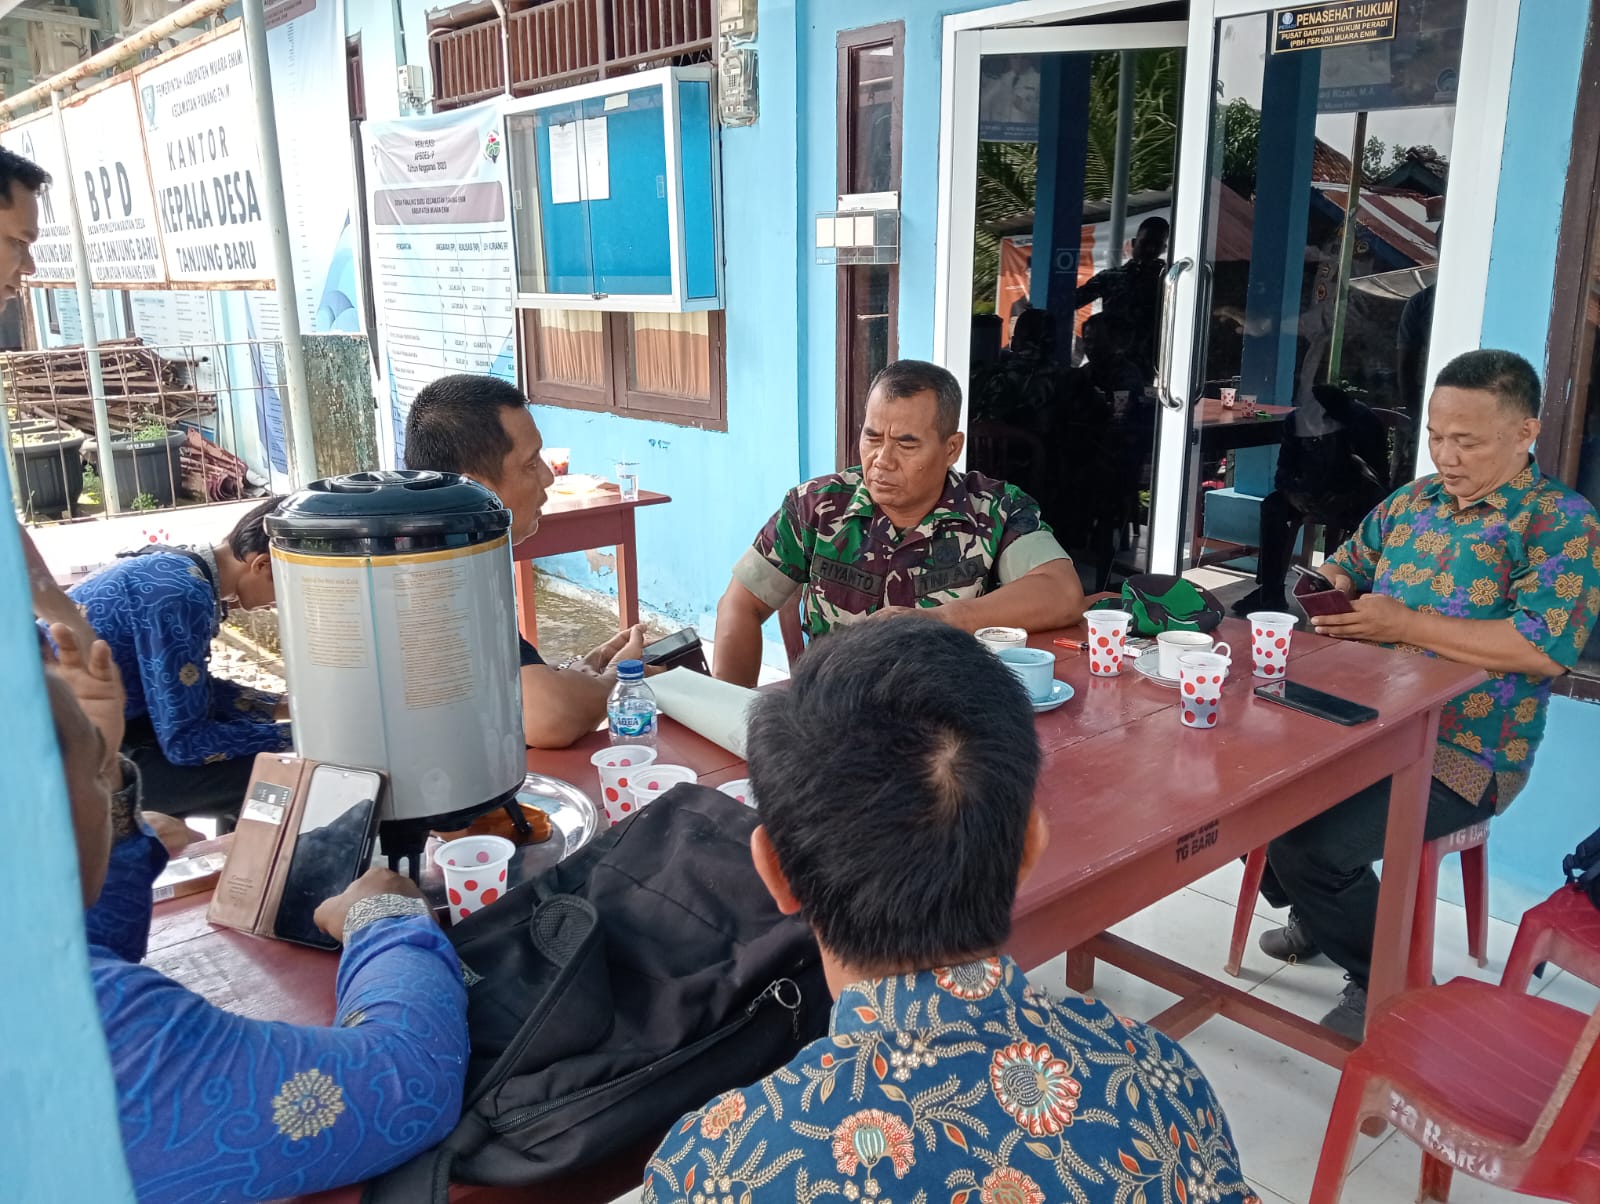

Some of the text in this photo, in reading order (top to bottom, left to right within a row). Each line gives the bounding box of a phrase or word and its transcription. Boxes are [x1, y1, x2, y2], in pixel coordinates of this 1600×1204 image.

[1296, 1, 1394, 26] PENASEHAT HUKUM
[1281, 19, 1388, 40] PUSAT BANTUAN HUKUM PERADI
[1290, 30, 1377, 48] (PBH PERADI) MUARA ENIM
[209, 56, 228, 76] MUARA
[167, 125, 229, 171] KANTOR
[84, 161, 132, 222] BPD
[159, 170, 262, 234] KEPALA DESA
[102, 238, 136, 262] TANJUNG
[135, 236, 159, 260] BARU
[176, 240, 256, 273] TANJUNG BARU
[819, 561, 875, 591] RIYANTO
[918, 560, 979, 592] TNI AD
[1191, 829, 1218, 856] BARU
[1423, 1118, 1502, 1180] BARU
